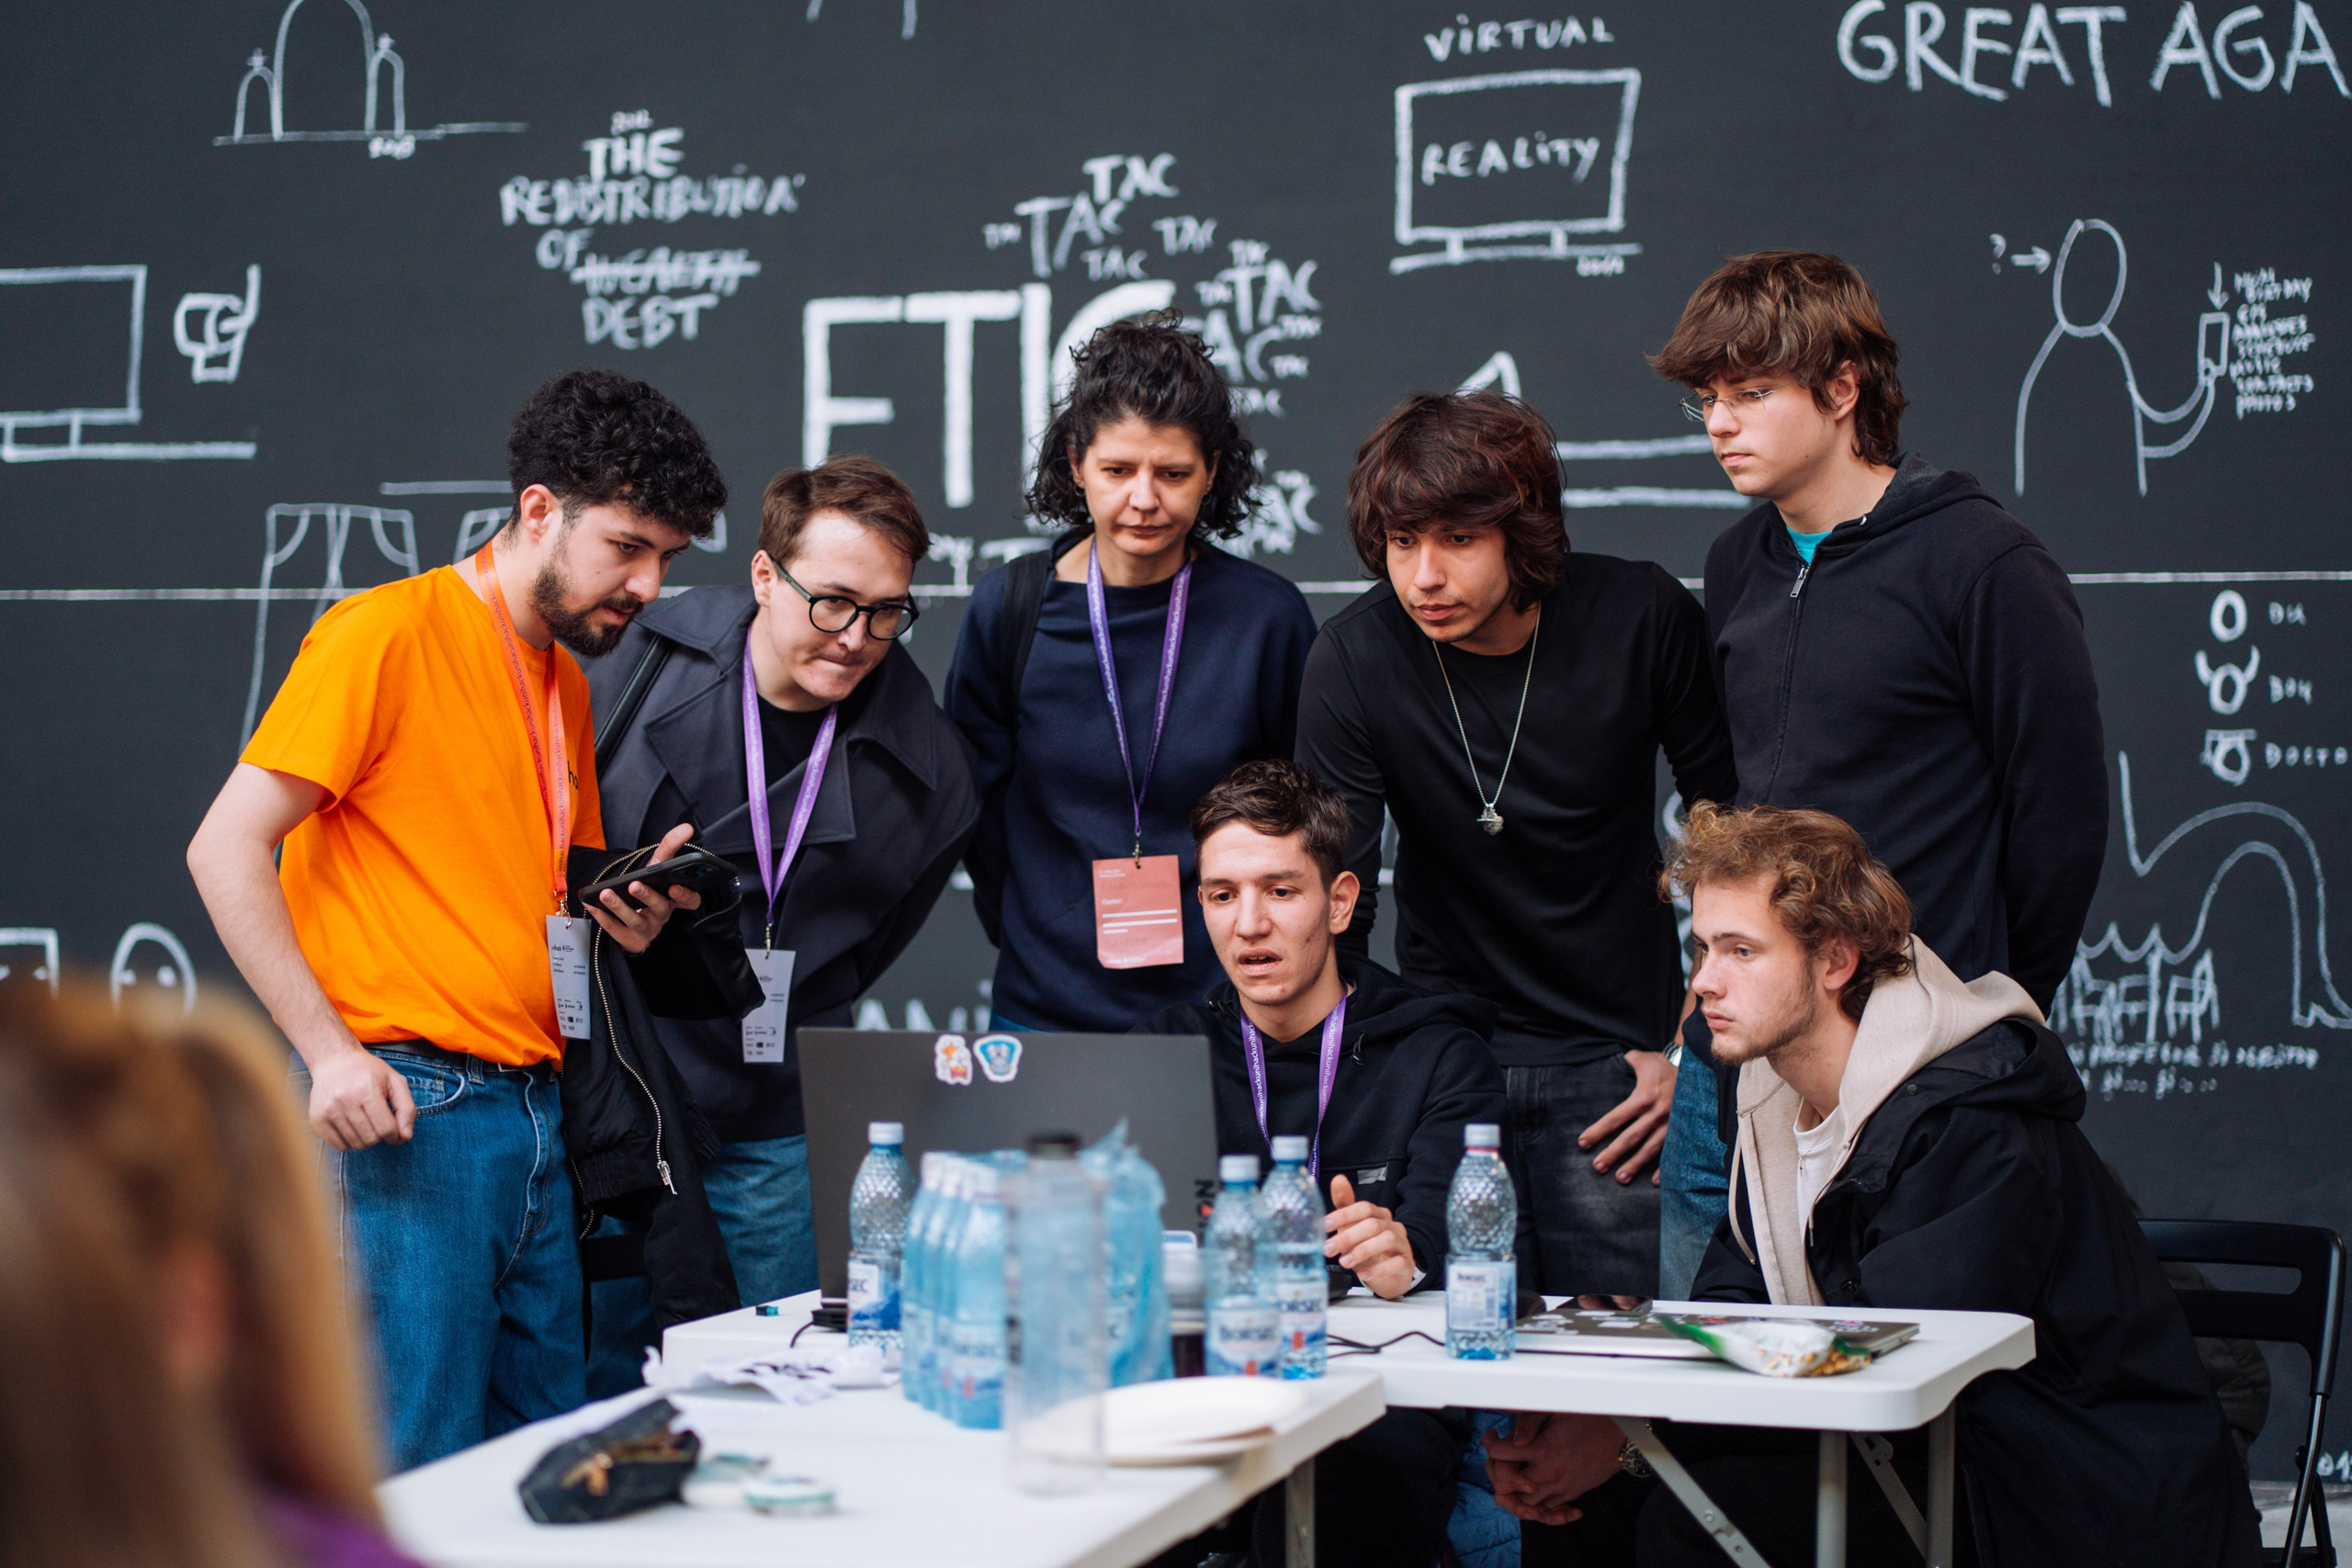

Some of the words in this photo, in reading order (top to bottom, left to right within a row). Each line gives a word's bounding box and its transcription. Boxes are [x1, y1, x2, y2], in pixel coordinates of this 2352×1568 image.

[1837, 0, 2128, 108] GREAT
[582, 127, 685, 184] THE
[1082, 152, 1180, 204] TAC
[535, 227, 594, 272] OF
[1014, 191, 1126, 278] TAC
[1080, 245, 1148, 281] TAC
[582, 293, 719, 350] DEBT
